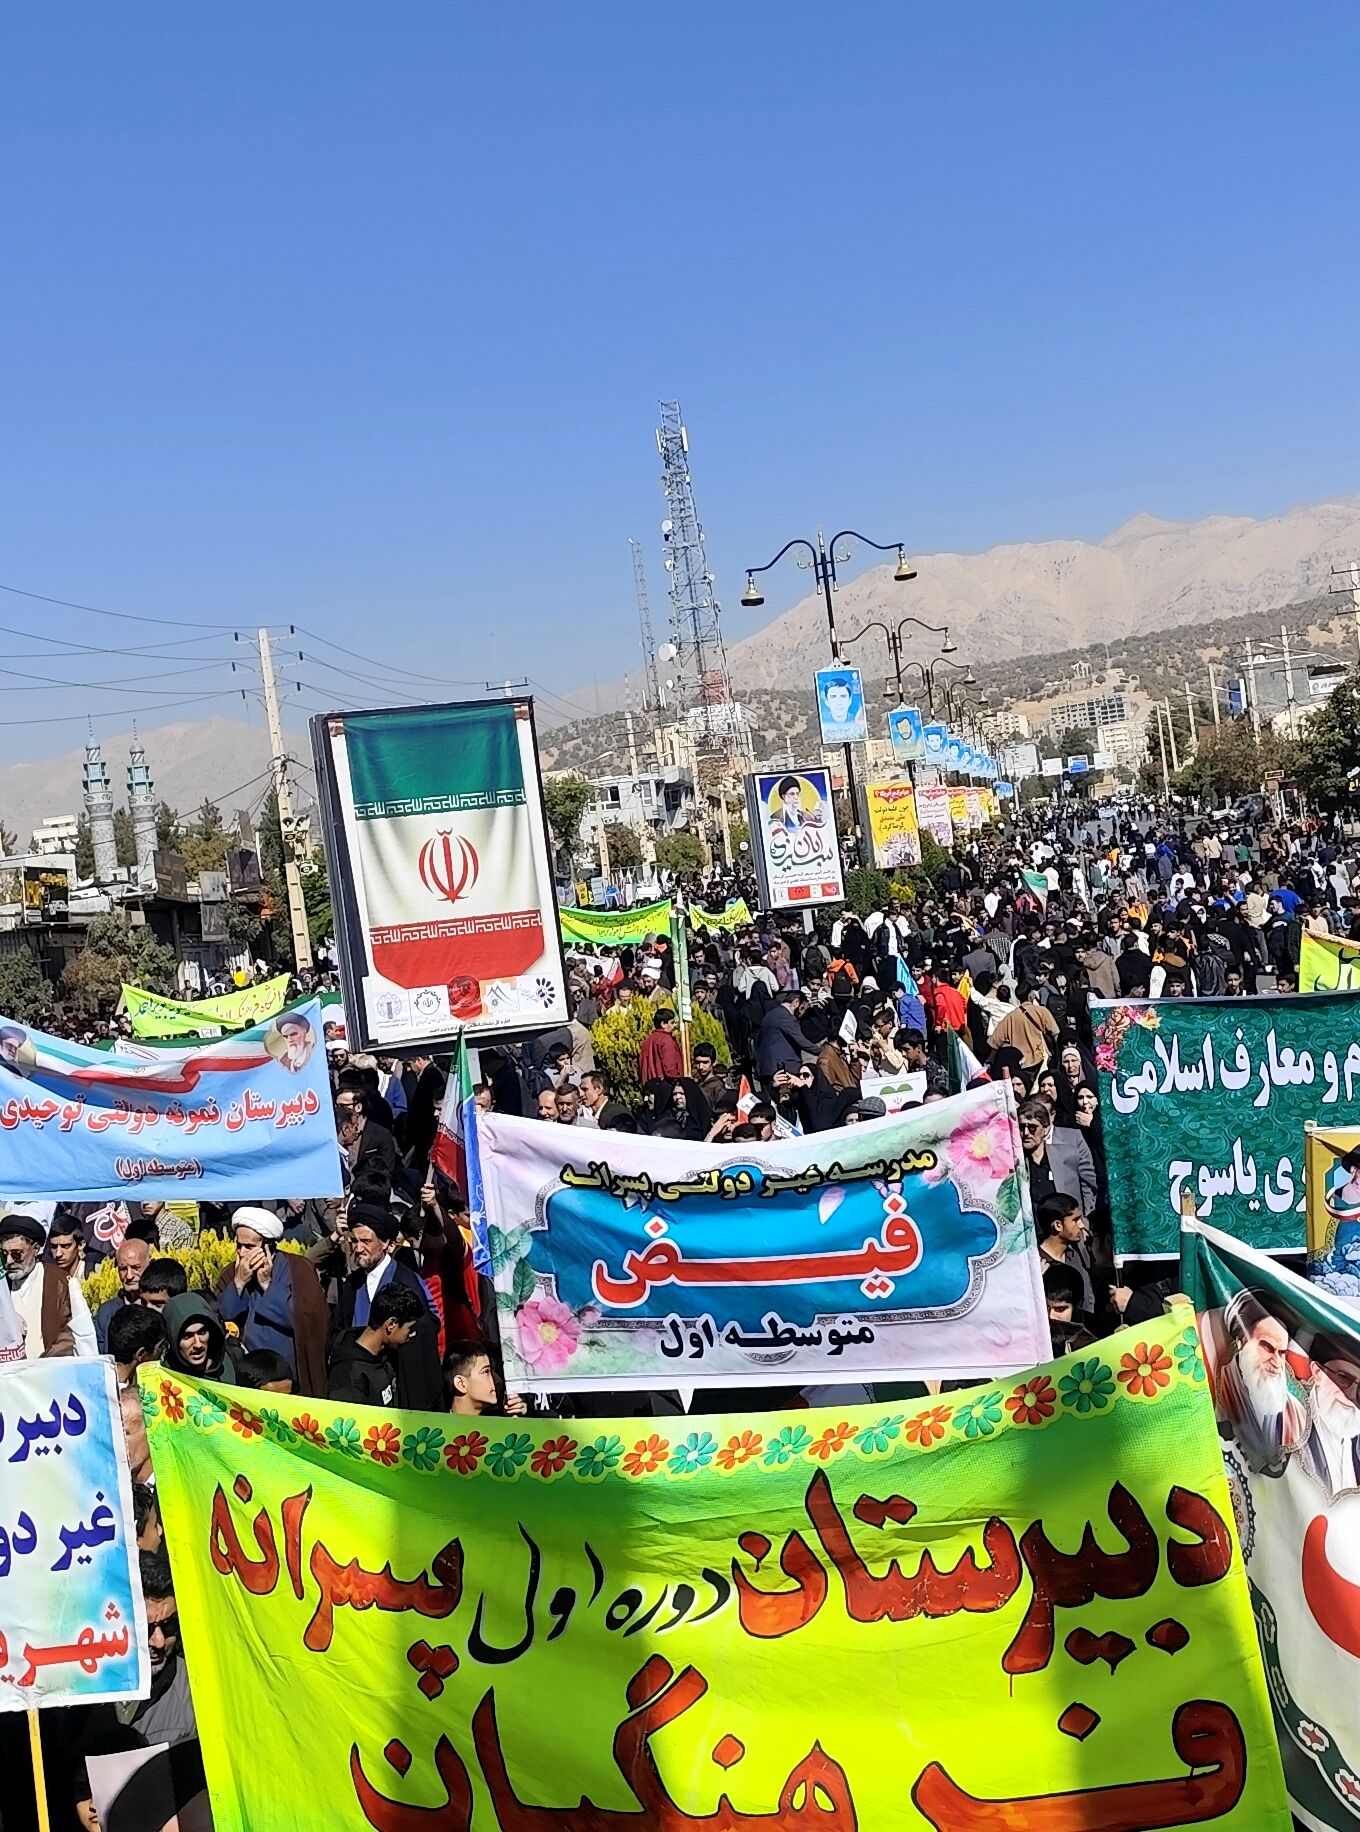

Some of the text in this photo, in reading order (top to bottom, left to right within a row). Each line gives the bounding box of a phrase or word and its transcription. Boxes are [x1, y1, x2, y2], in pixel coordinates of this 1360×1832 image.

[1109, 1032, 1215, 1114] اسلامی
[1219, 1027, 1317, 1108] معارف
[1322, 1056, 1339, 1104] و
[85, 1097, 160, 1135] دولتی
[165, 1096, 223, 1135] نمونه
[224, 1088, 321, 1133] دبیرستان
[561, 1148, 938, 1212] مدرسه غیر دولتی پسرانه
[1168, 1137, 1261, 1217] یاسوج
[594, 1194, 924, 1306] فیض
[659, 1314, 876, 1360] متوسطه اول
[50, 1490, 117, 1573] غیر
[209, 1467, 1234, 1701] دبیرستان دوره اول پسرانه
